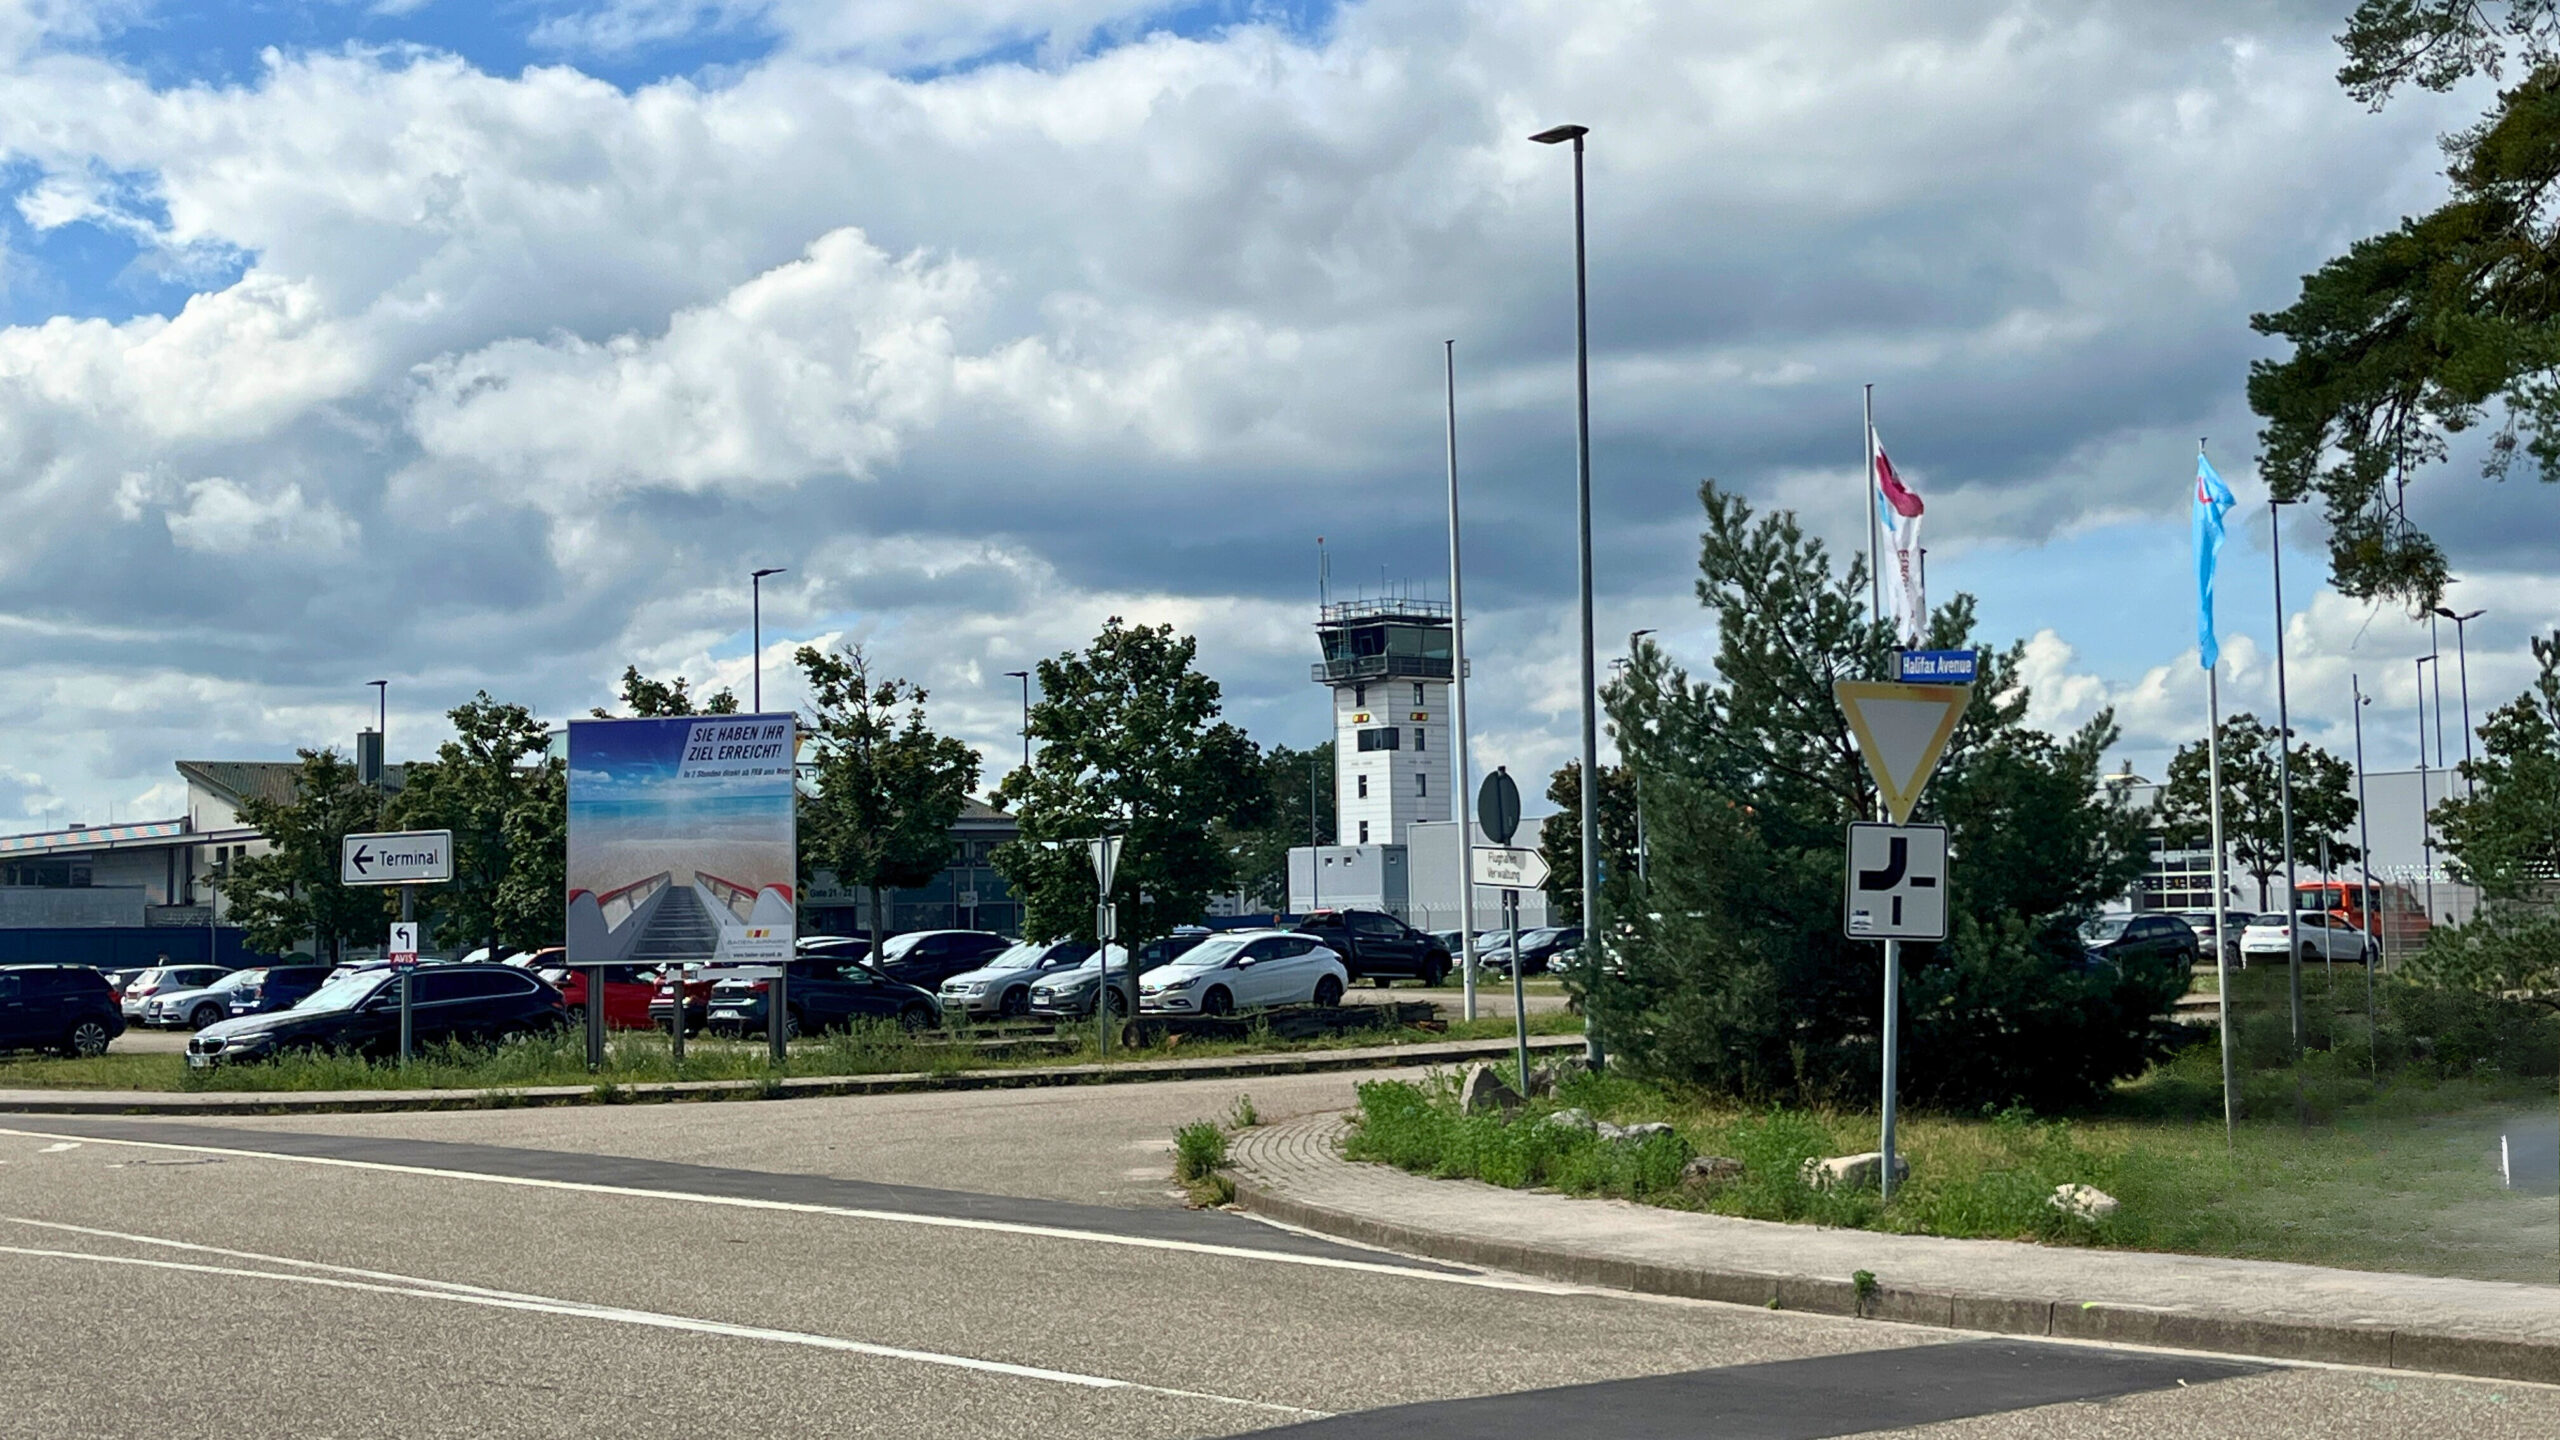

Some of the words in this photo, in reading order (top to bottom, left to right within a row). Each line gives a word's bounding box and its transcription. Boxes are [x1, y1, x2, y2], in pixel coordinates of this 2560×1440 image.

[1902, 656, 1936, 674] Halifax
[1937, 656, 1972, 674] Avenue
[694, 727, 715, 742] SIE
[717, 726, 759, 741] HABEN
[761, 725, 785, 740] IHR
[688, 745, 713, 761] ZIEL
[718, 744, 782, 760] ERREICHT!
[697, 769, 721, 778] Stunden
[379, 849, 439, 867] Terminal
[393, 954, 414, 963] AVIS
